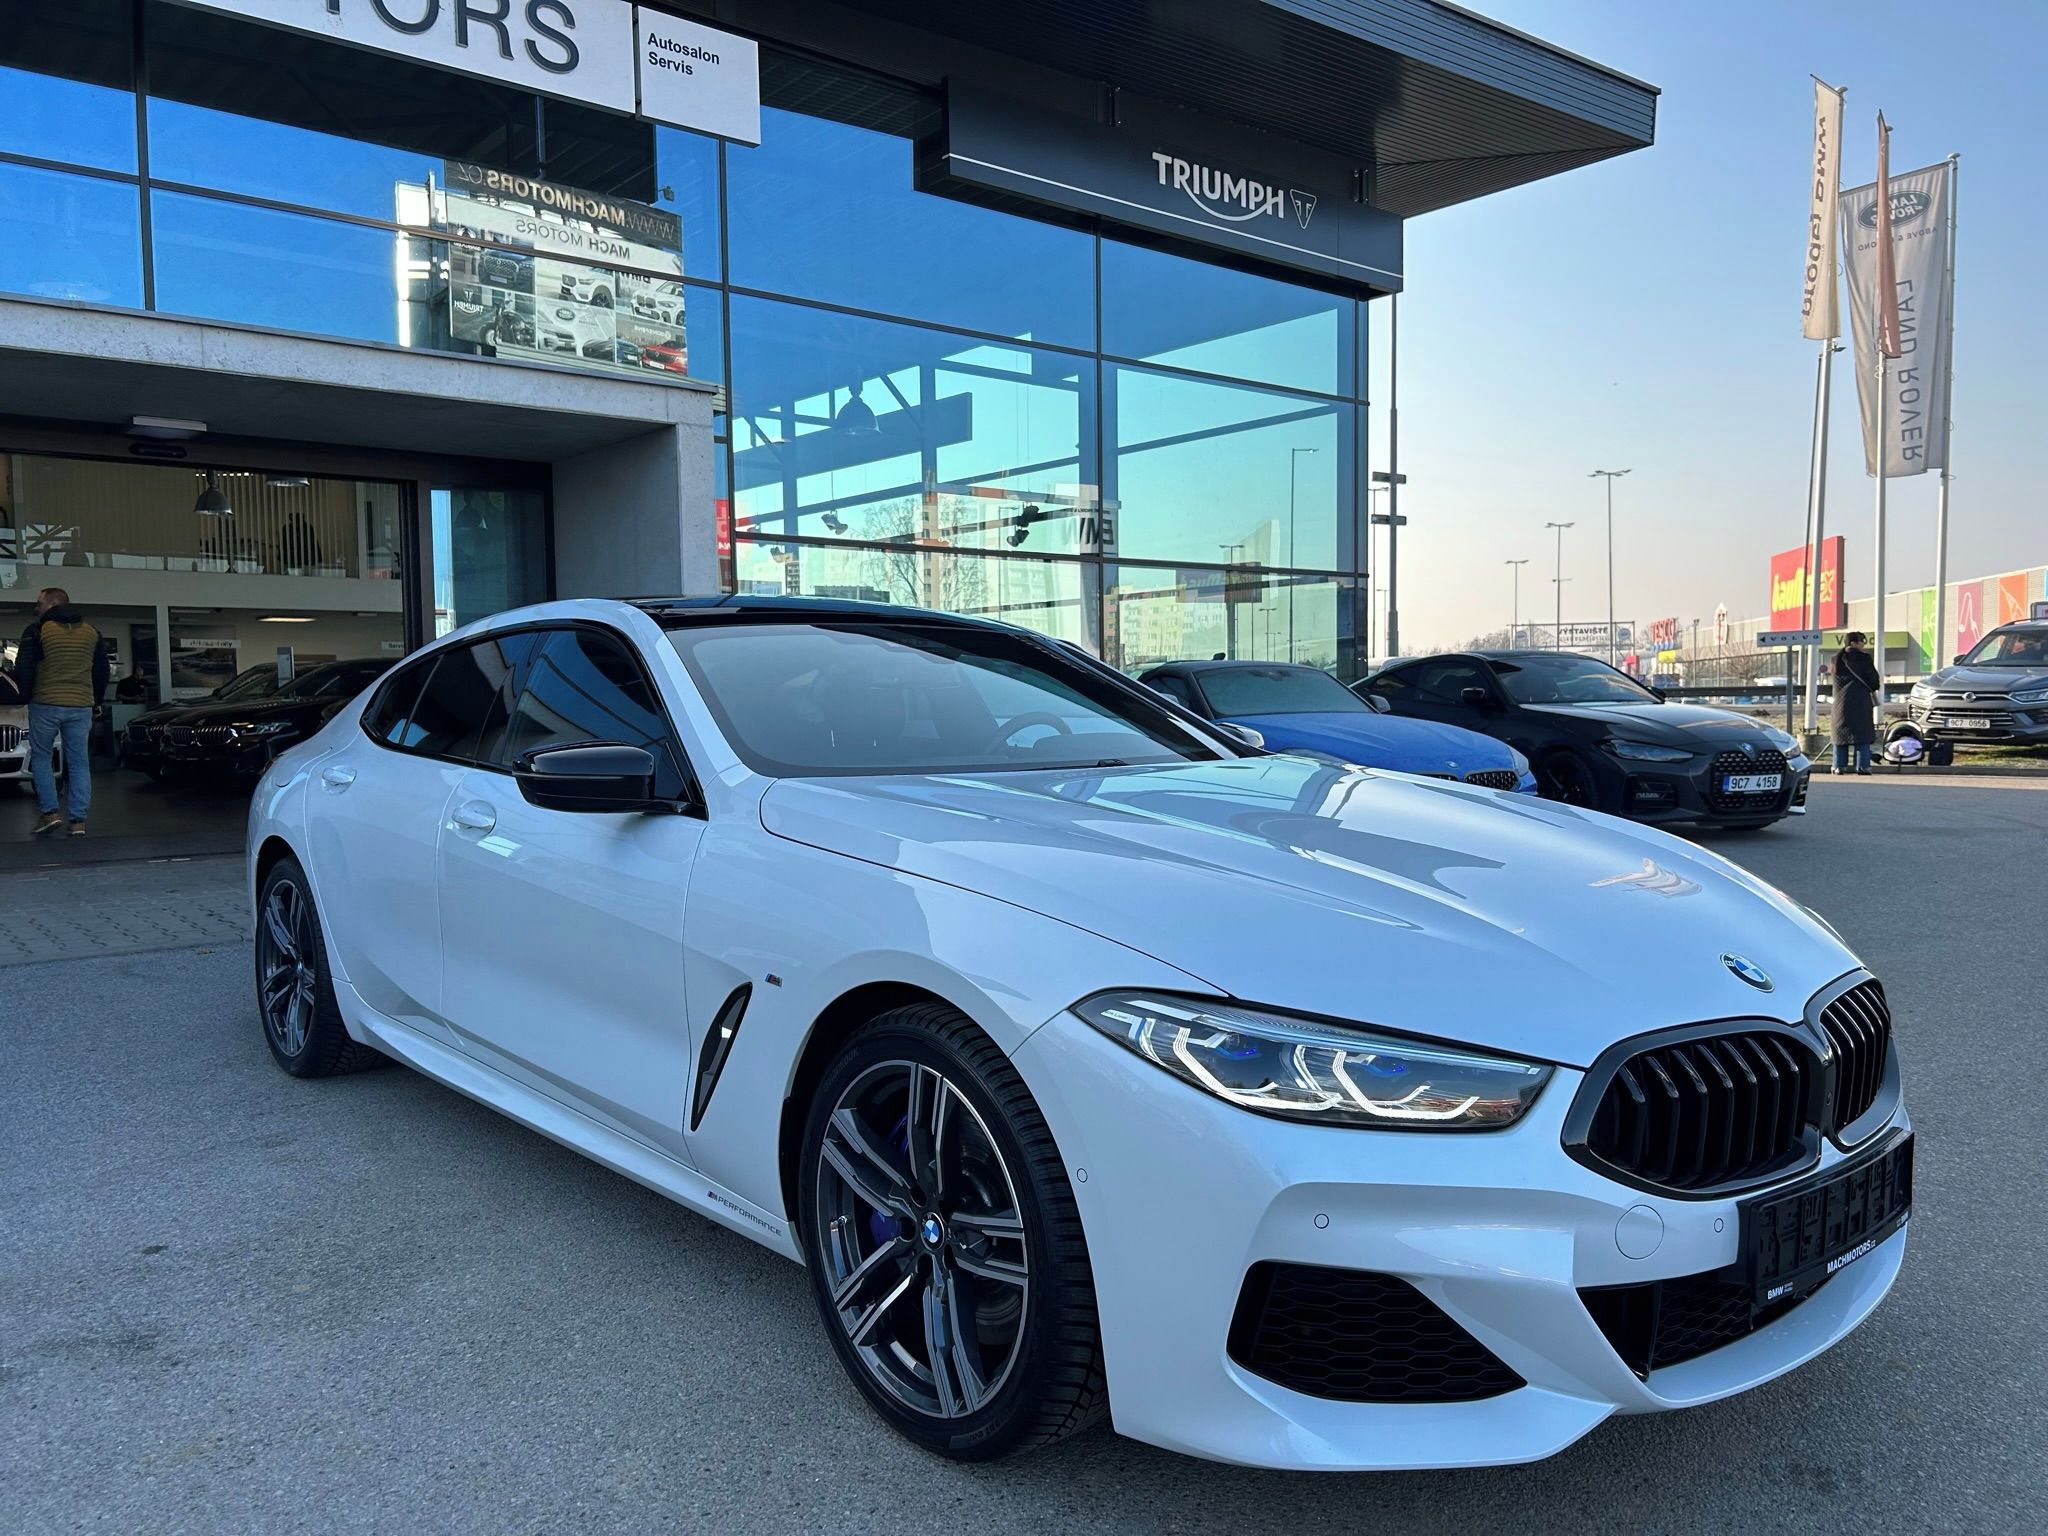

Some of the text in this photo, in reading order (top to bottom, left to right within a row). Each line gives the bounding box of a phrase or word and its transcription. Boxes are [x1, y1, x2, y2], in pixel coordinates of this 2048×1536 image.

[647, 32, 720, 66] Autosalon
[648, 51, 694, 77] Servis
[1152, 151, 1285, 222] TRIUMPH
[1651, 617, 1677, 643] TESCO
[1769, 634, 1819, 642] VOLVO
[1950, 719, 1963, 728] 9C7
[1731, 776, 1778, 790] 9C7 4158
[1767, 1284, 1784, 1300] BMW
